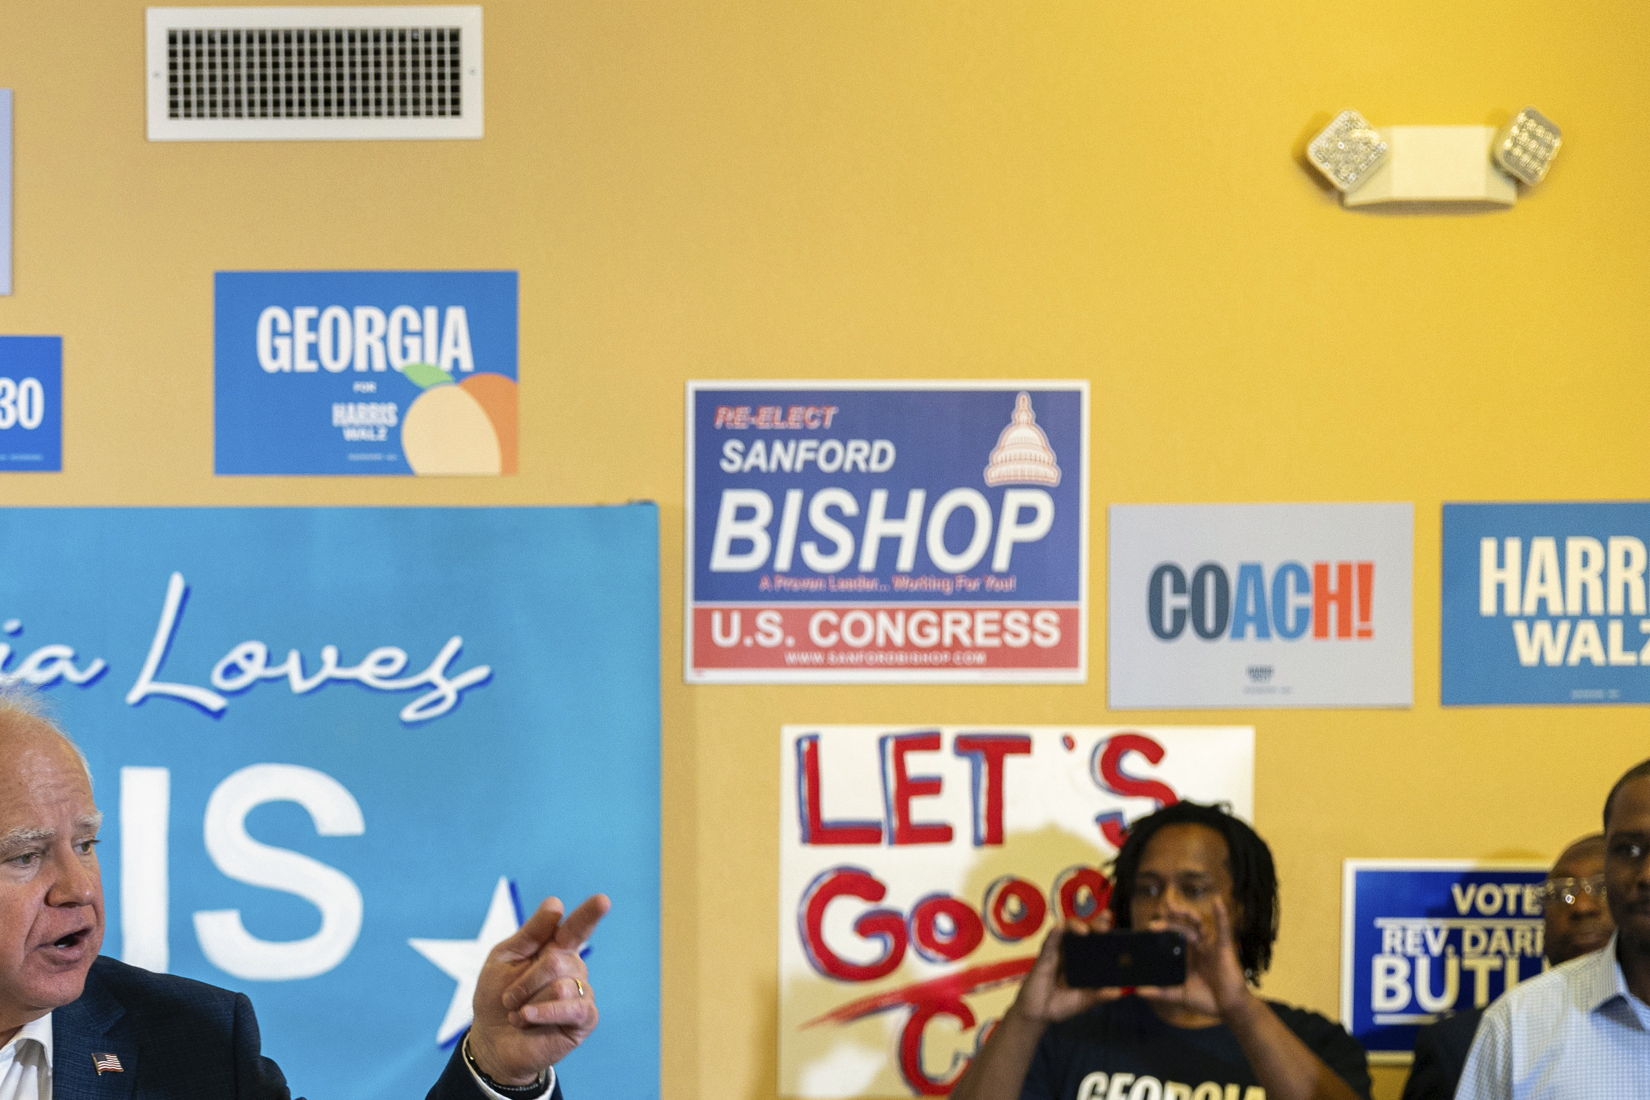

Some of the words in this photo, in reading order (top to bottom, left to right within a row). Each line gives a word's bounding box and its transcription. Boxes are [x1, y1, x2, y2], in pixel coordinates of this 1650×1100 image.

[256, 304, 474, 374] GEORGIA
[714, 404, 839, 430] RE-ELECT
[719, 438, 897, 474] SANFORD
[709, 487, 1056, 574] BISHOP
[1147, 559, 1375, 643] COACH!
[125, 570, 495, 727] Loves
[711, 609, 795, 648] U.S.
[808, 609, 1062, 650] CONGRESS
[1451, 882, 1544, 916] VOTE
